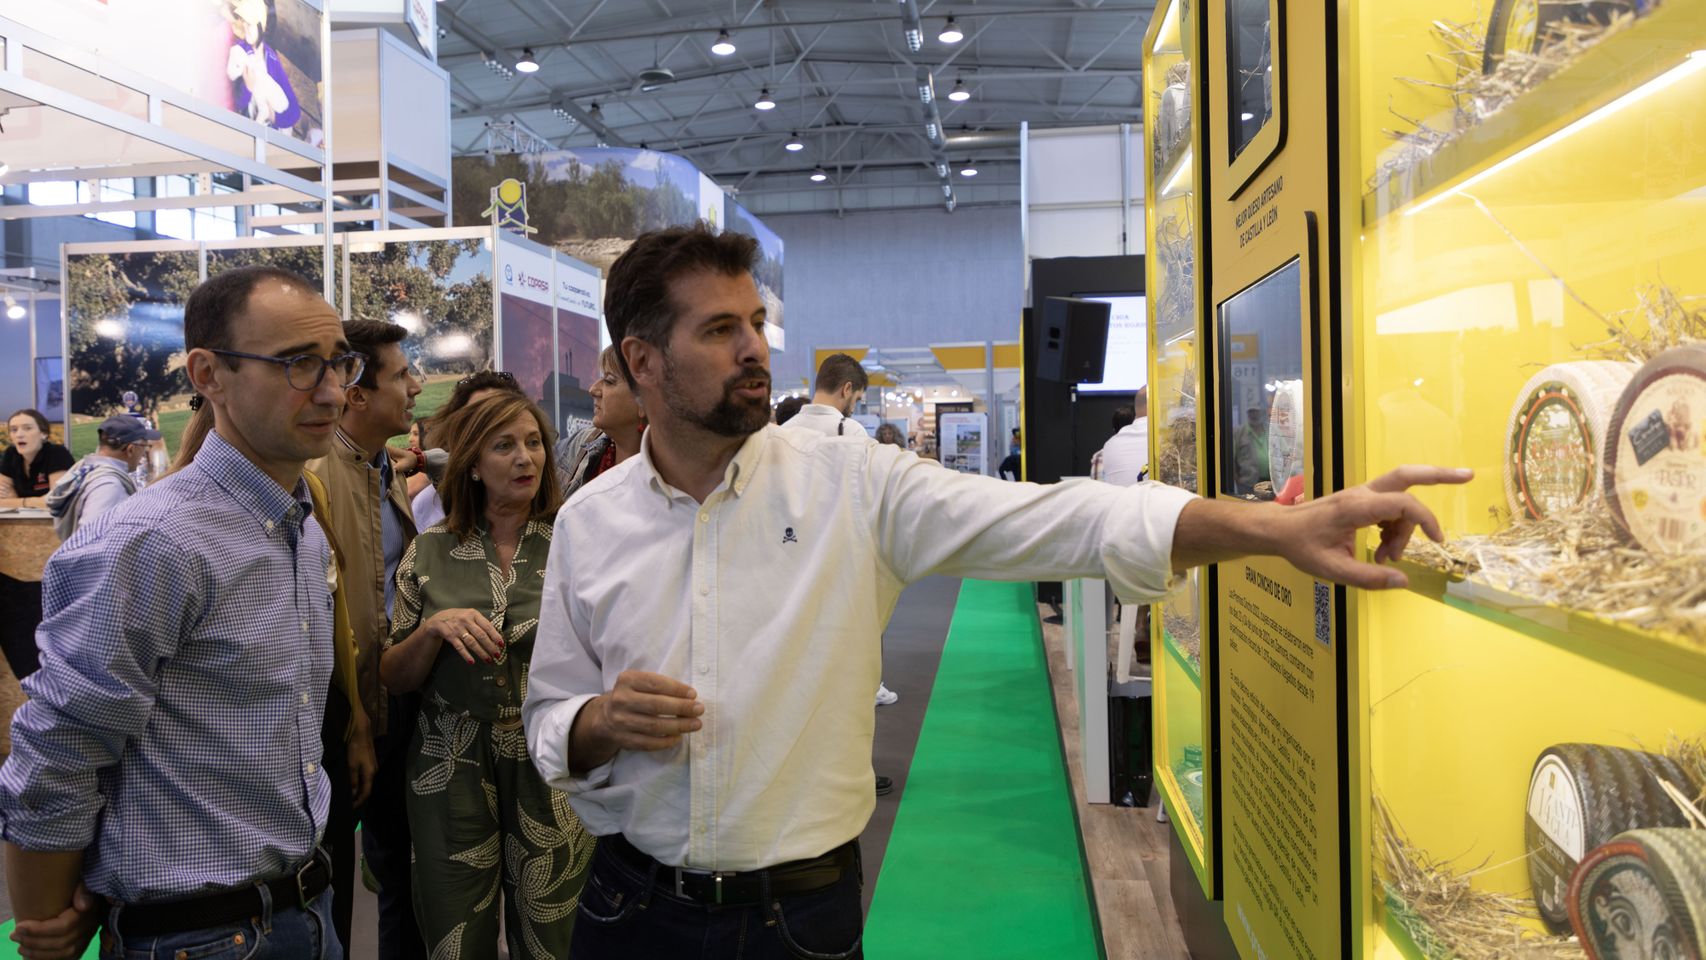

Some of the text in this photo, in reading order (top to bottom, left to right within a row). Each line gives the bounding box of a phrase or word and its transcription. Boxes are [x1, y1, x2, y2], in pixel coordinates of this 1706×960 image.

[1235, 175, 1283, 229] MEJOR QUESO ARTESANO
[1245, 218, 1263, 244] CASTILLA
[1245, 566, 1292, 607] GRAN CINCHO DE ORO
